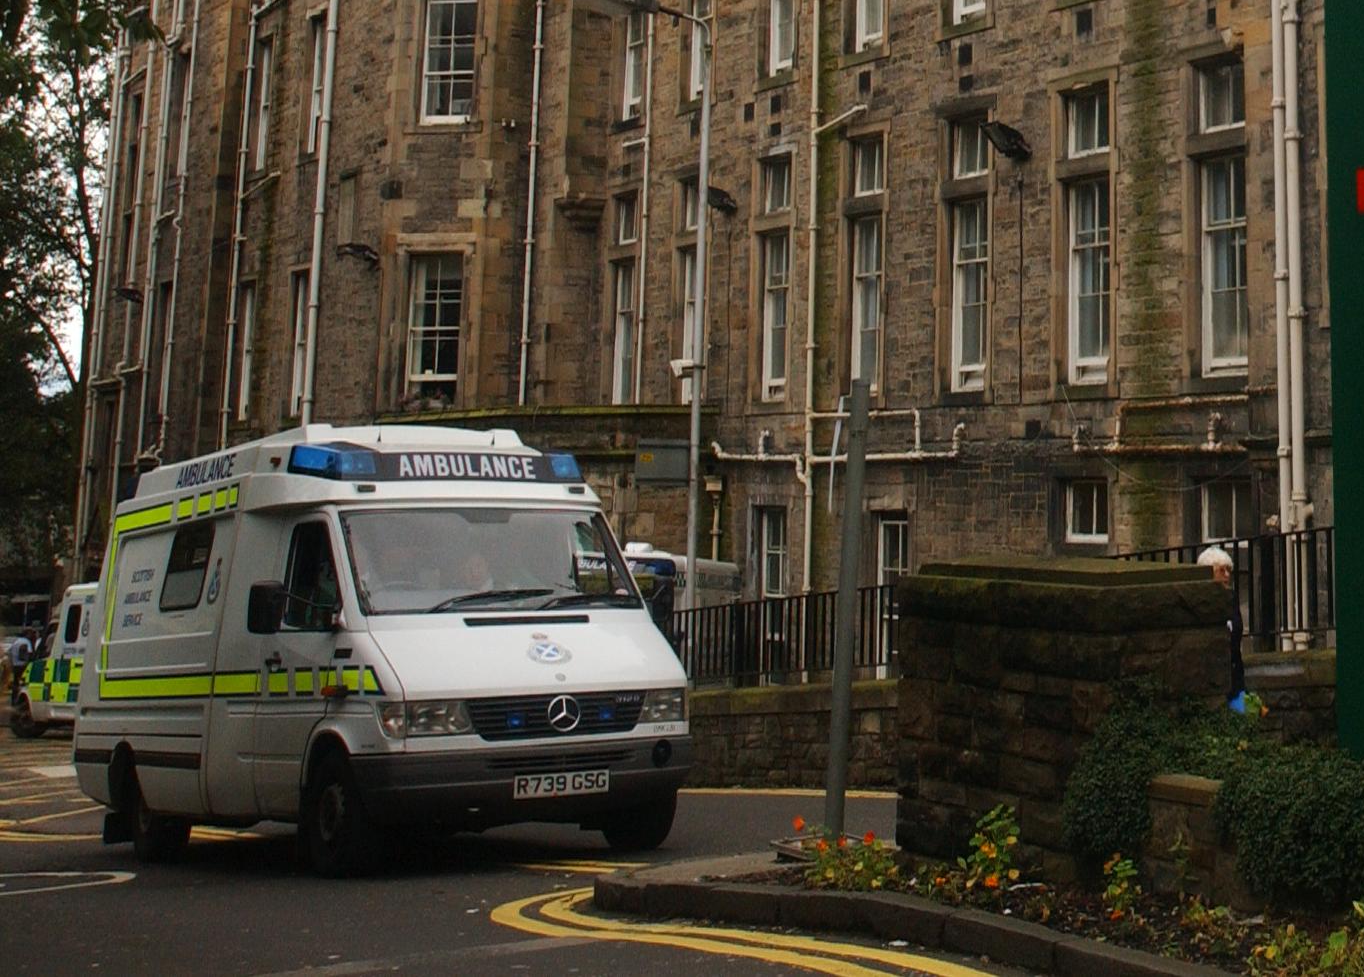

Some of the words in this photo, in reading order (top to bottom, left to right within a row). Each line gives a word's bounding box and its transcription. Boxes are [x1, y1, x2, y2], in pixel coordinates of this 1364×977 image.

[176, 453, 236, 488] AMBULANCE
[400, 454, 536, 479] AMBULANCE
[517, 777, 566, 795] R739
[572, 772, 607, 791] GSG
